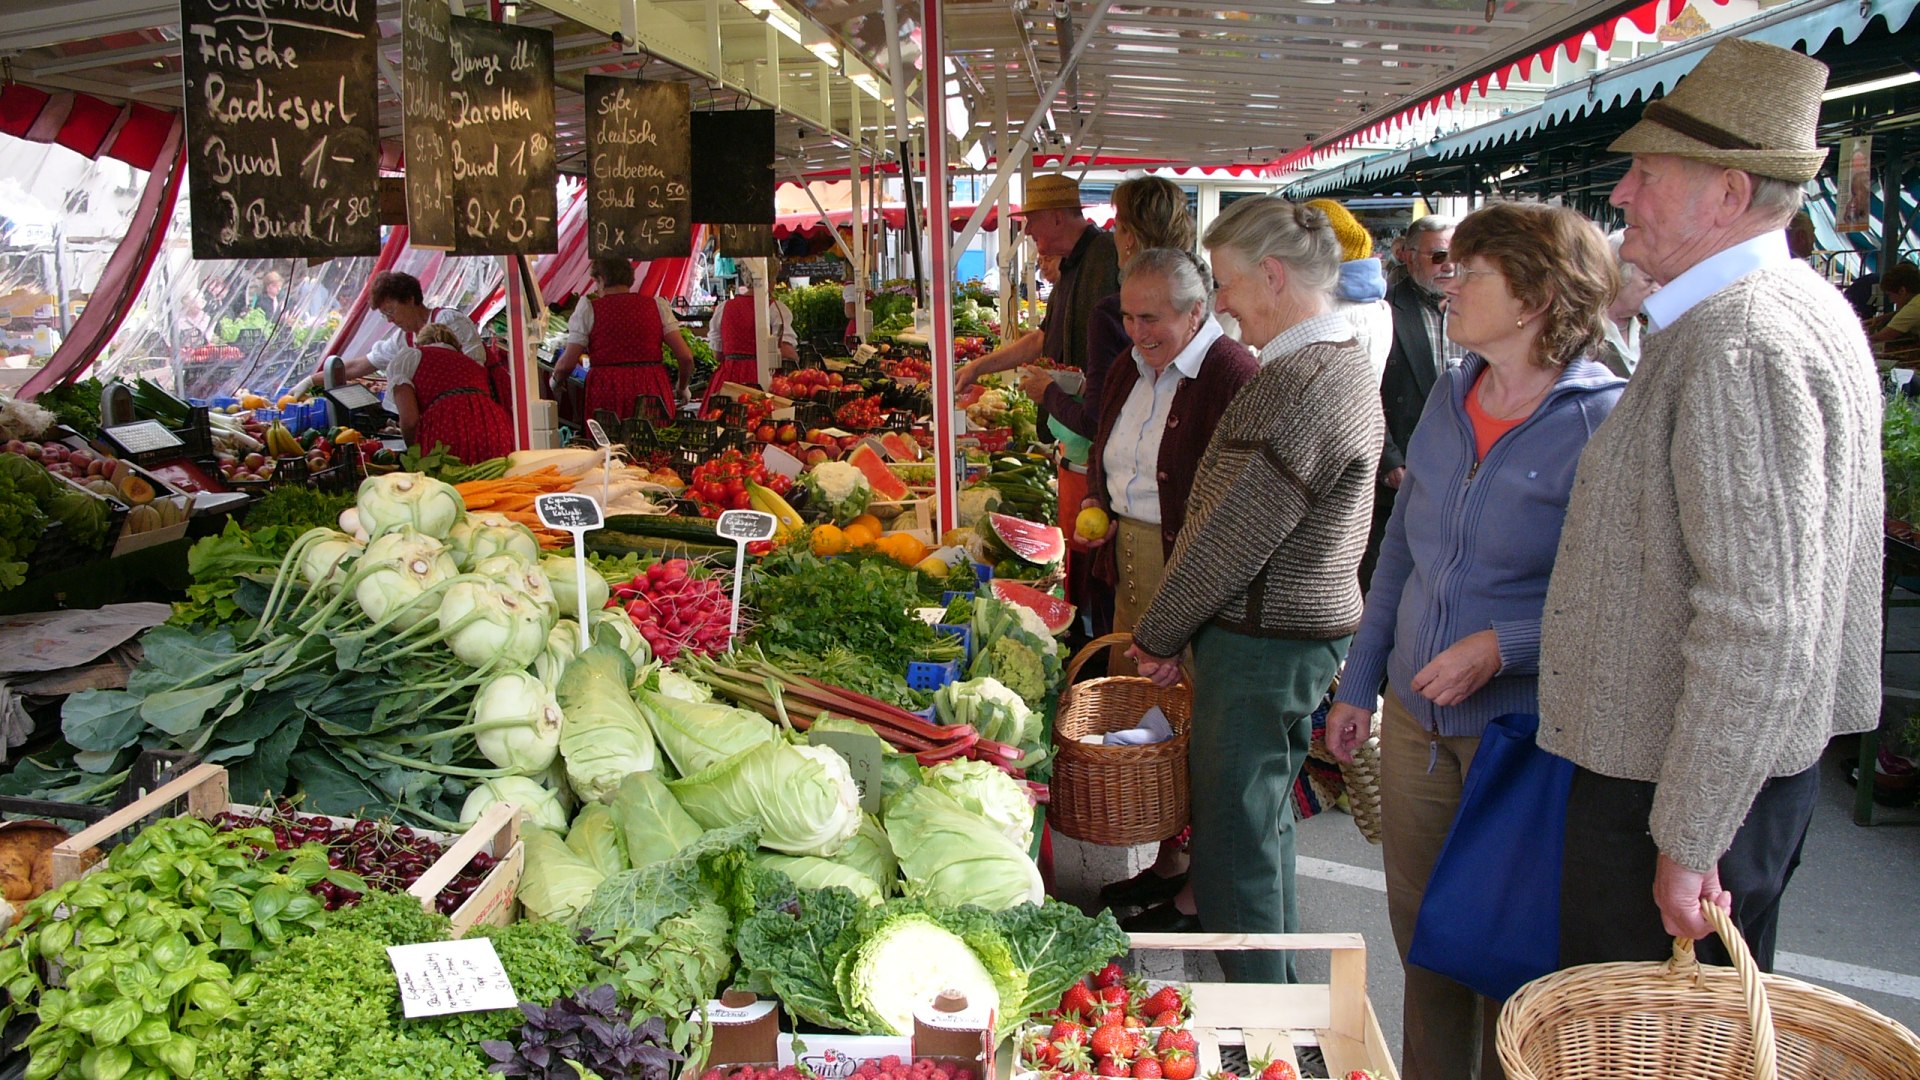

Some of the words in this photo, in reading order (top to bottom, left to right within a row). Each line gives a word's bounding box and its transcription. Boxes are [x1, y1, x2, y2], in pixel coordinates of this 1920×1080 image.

[190, 24, 299, 69] Frische
[447, 86, 531, 129] Karotten
[597, 117, 658, 146] deutsche
[204, 136, 282, 184] Bund
[452, 140, 499, 180] Bund
[593, 153, 665, 180] Erdbeeren
[597, 184, 636, 208] Schale
[245, 198, 318, 244] Bund
